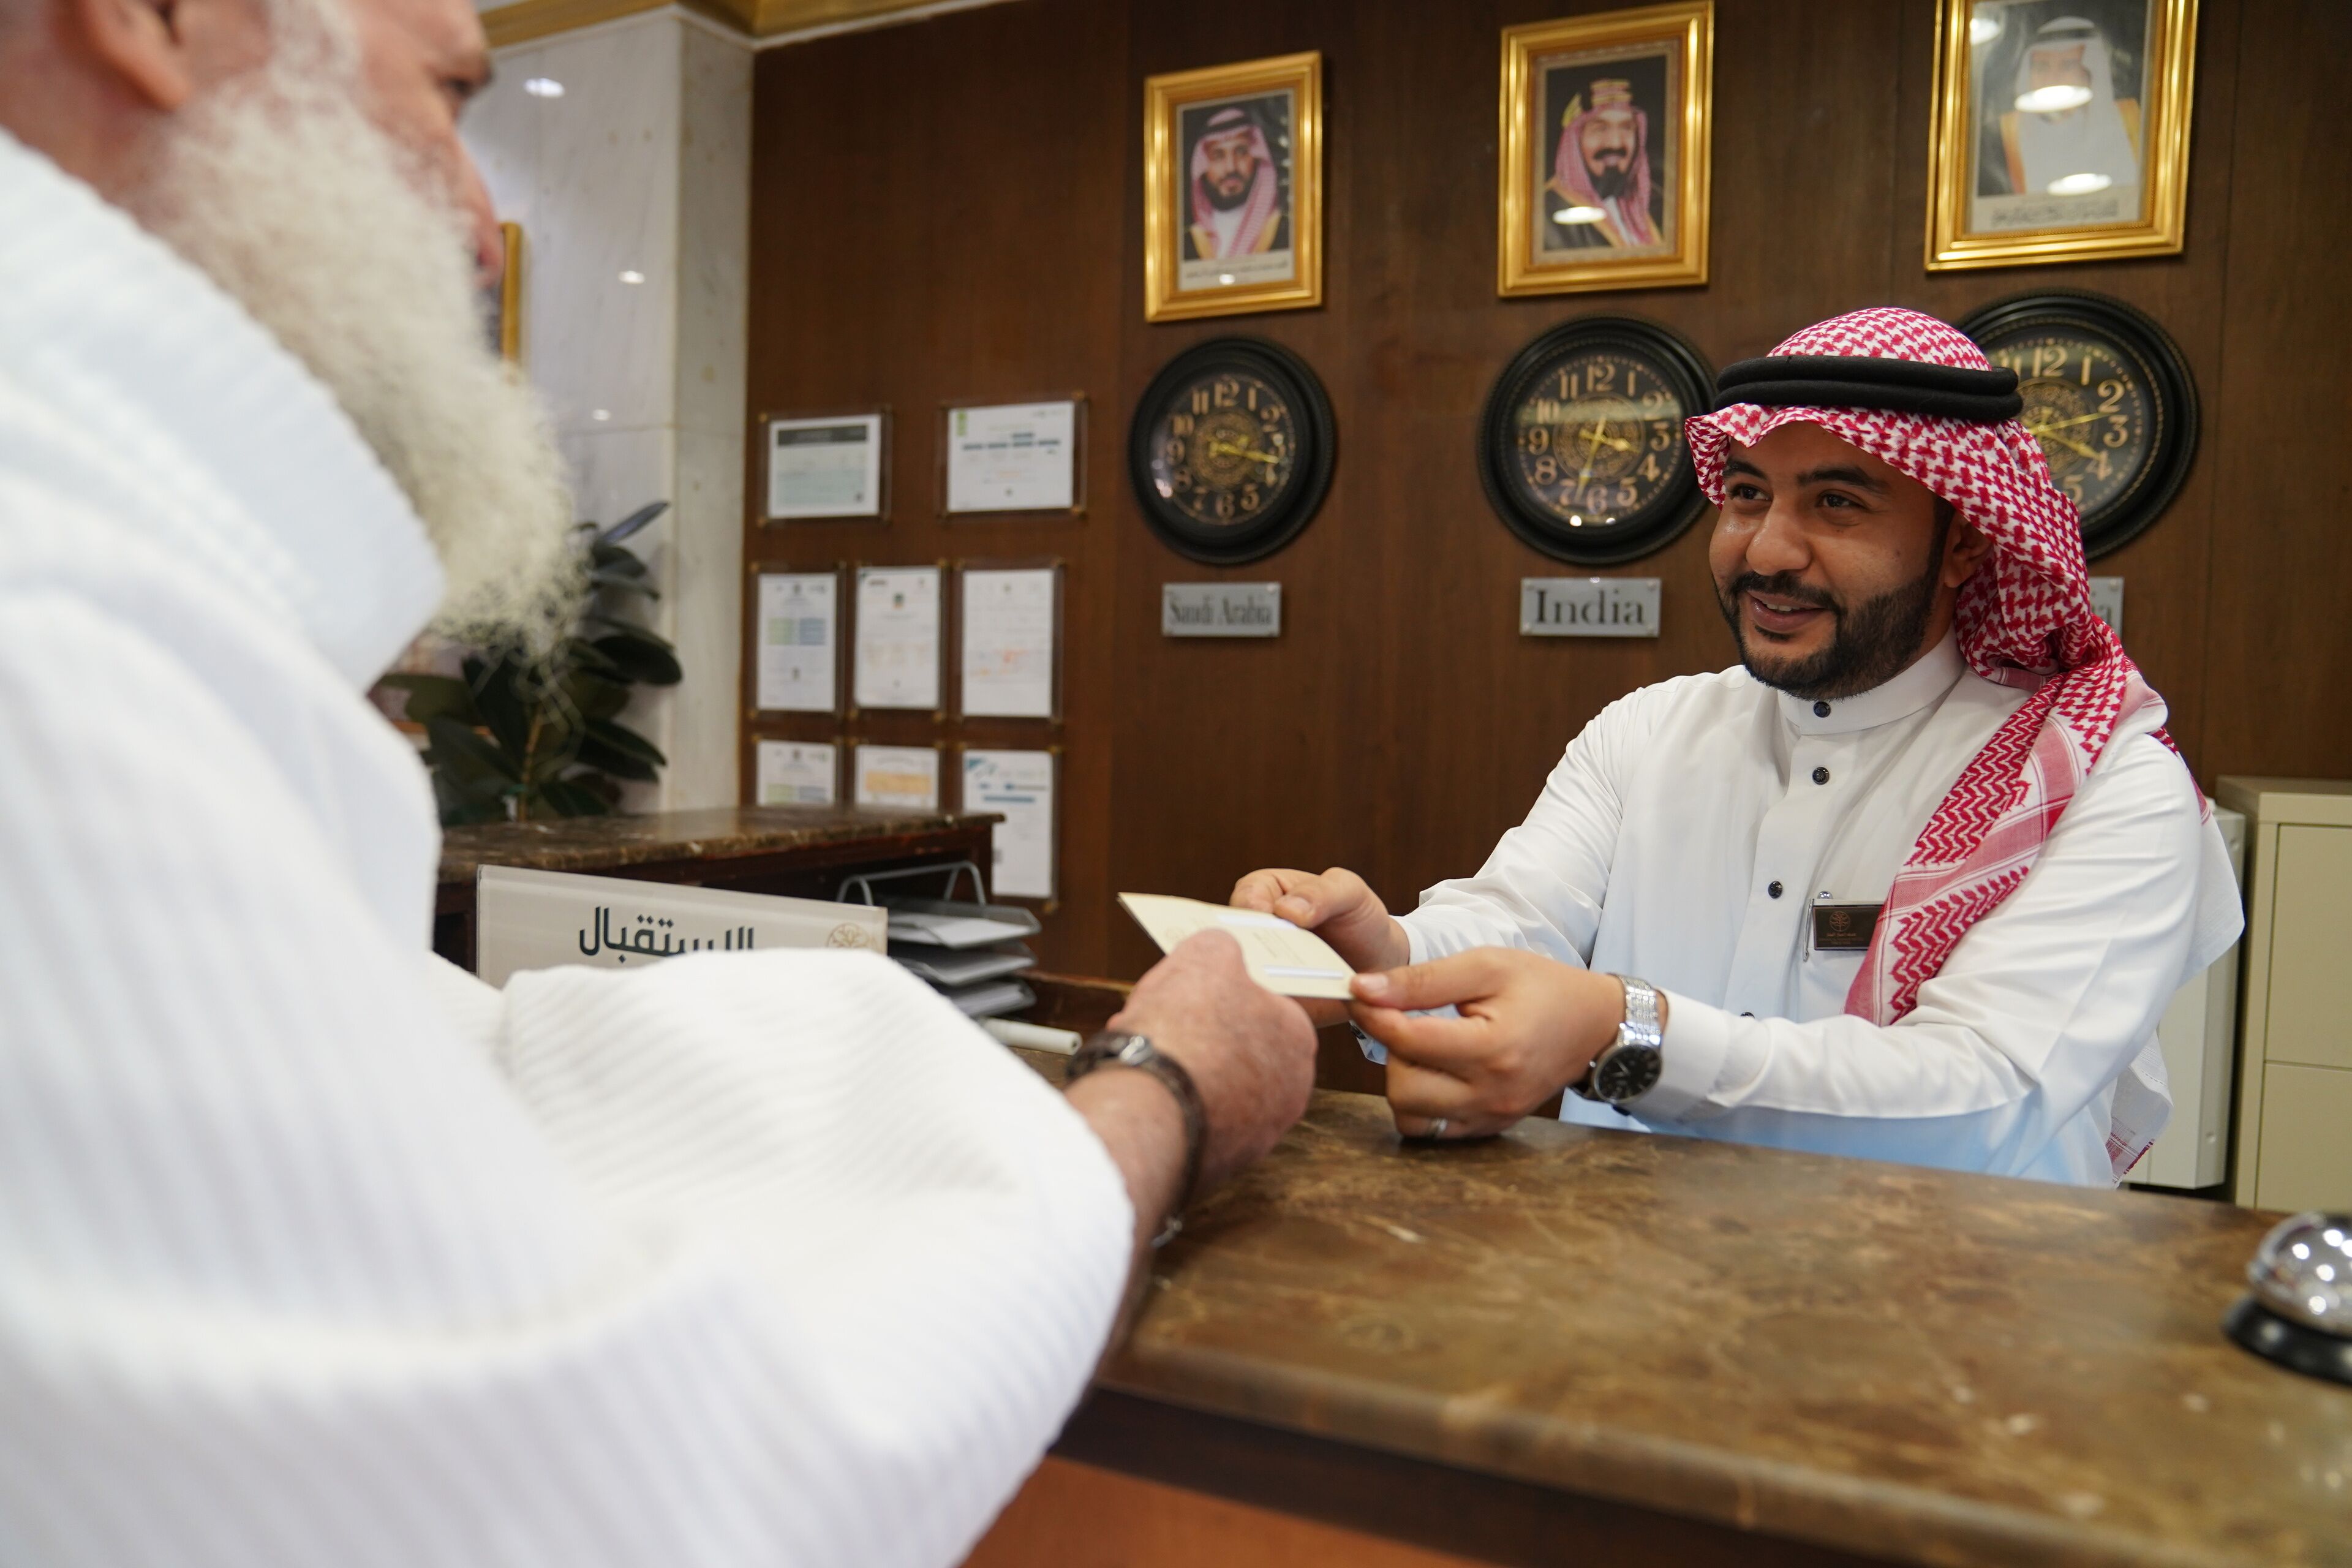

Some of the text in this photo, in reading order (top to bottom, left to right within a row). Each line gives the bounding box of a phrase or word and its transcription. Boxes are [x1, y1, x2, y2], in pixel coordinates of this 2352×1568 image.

[2032, 345, 2068, 377] 12
[2081, 356, 2091, 386] 1
[1560, 373, 1578, 399] 11
[1587, 363, 1616, 392] 12
[1627, 371, 1636, 397] 1
[1192, 390, 1209, 415] 11
[1214, 378, 1240, 407] 12
[1248, 385, 1257, 411] 1
[1642, 390, 1664, 421] 2
[2097, 379, 2125, 413] 2
[1173, 414, 1194, 436] 10
[1261, 404, 1281, 432] 2
[1536, 398, 1560, 424] 10
[1528, 425, 1550, 456] 9
[1650, 422, 1671, 451] 3
[2103, 414, 2128, 447] 3
[1166, 439, 1185, 466] 9
[2086, 450, 2113, 480] 4
[1172, 466, 1192, 492] 8
[1535, 455, 1558, 485] 8
[1637, 453, 1661, 482] 4
[1195, 484, 1208, 511] 7
[1215, 491, 1235, 518] 6
[1240, 483, 1259, 511] 5
[1559, 478, 1578, 506] 7
[1586, 484, 1608, 515] 6
[1616, 476, 1638, 507] 5
[1169, 594, 1272, 625] Saudi Arabia
[1537, 588, 1644, 624] India
